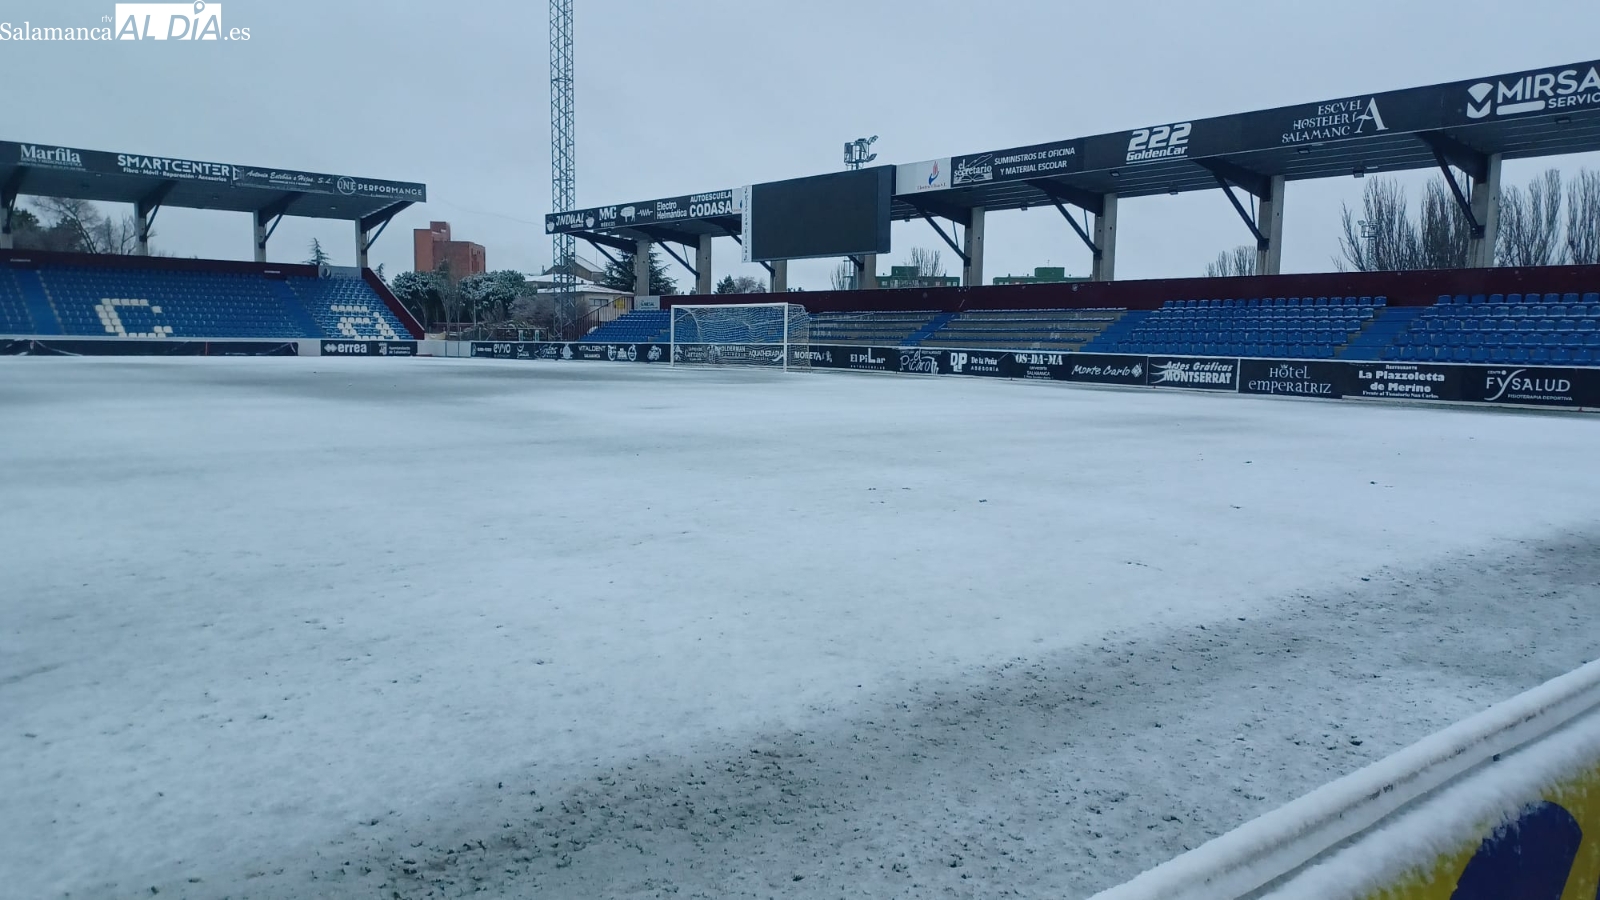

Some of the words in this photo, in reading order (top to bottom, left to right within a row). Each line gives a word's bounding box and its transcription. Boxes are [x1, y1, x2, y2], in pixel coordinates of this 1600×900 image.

[1127, 122, 1192, 152] 222
[20, 144, 81, 163] Marfila
[994, 152, 1037, 166] SUMINISTROS
[1037, 151, 1047, 159] DE
[1047, 147, 1075, 158] OFICINA
[1126, 146, 1188, 162] GoldenCar
[117, 154, 230, 177] SMARTCENTER
[958, 159, 966, 170] el
[1000, 168, 1006, 176] Y
[1005, 164, 1037, 176] MATERIAL
[1037, 160, 1067, 171] ESCOLAR
[358, 183, 422, 196] PERFORMANCE
[690, 190, 732, 203] AUTOESCUELA
[656, 202, 677, 212] Electro
[689, 200, 732, 218] CODASA
[337, 343, 368, 353] errea
[850, 354, 858, 363] El
[970, 356, 979, 364] De
[984, 357, 998, 365] Peña
[1015, 353, 1063, 366] OS-DA-MA
[1071, 363, 1101, 376] Monte
[1102, 364, 1131, 377] Carlo
[1166, 361, 1189, 370] Artes
[1193, 361, 1234, 373] Gráficas
[1163, 370, 1232, 384] MONTSERRAT
[1358, 370, 1373, 379] La
[1370, 382, 1385, 390] de
[1387, 382, 1432, 393] Merino
